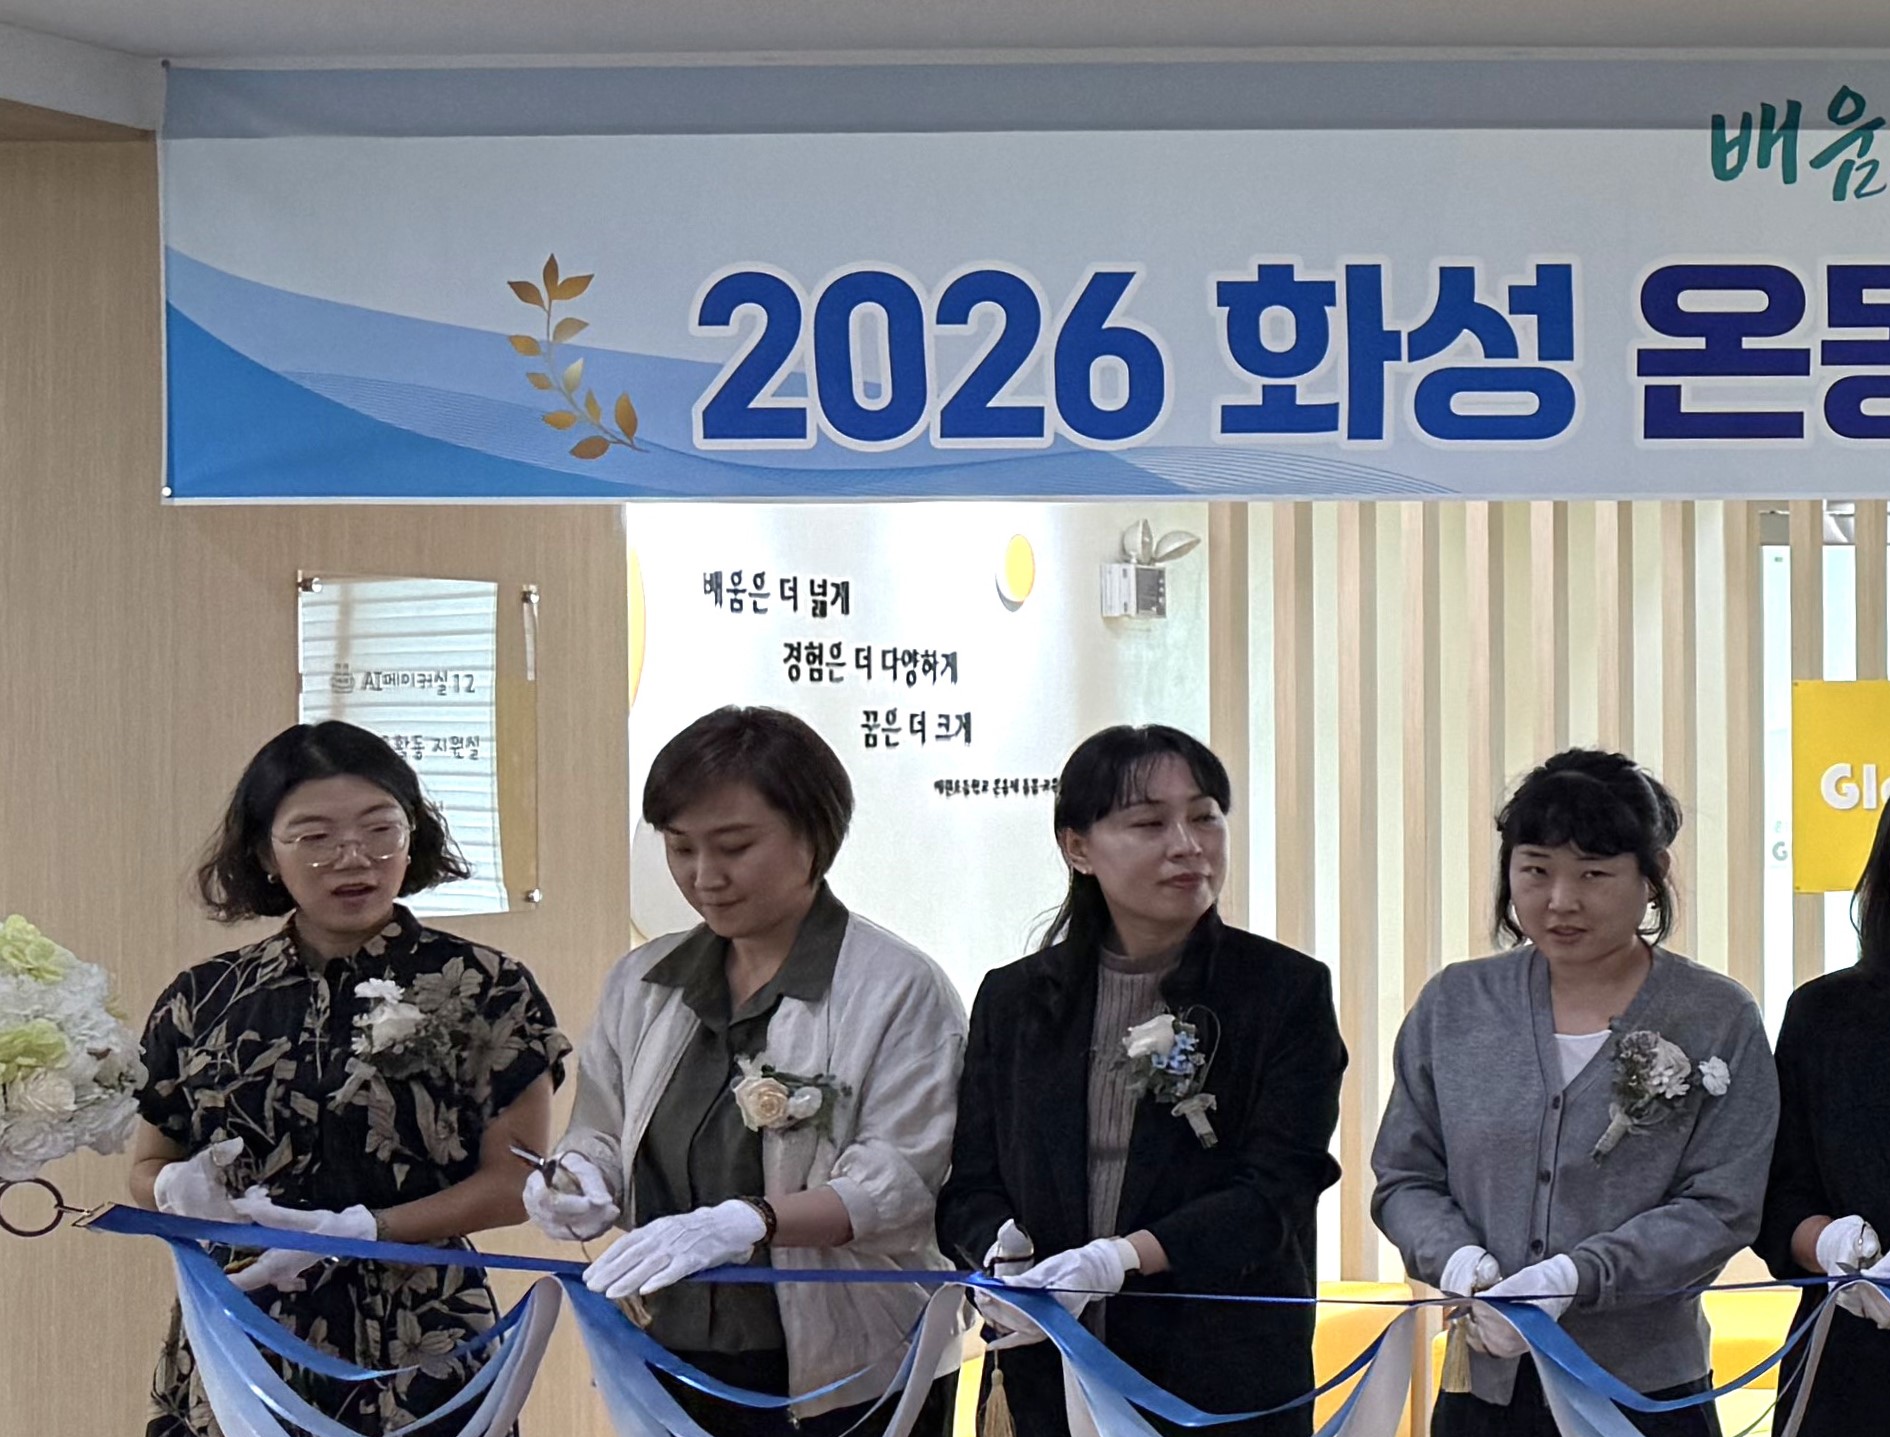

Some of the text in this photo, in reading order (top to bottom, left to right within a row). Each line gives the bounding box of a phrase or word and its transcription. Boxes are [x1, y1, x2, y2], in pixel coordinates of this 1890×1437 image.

[699, 270, 1165, 442] 2026
[1216, 264, 1576, 442] 화성
[702, 569, 851, 619] 배움은 더 넓게
[782, 641, 959, 688] 경험은 더 다양하게
[431, 735, 481, 761] 지원실
[860, 707, 973, 749] 꿈은 더 크게
